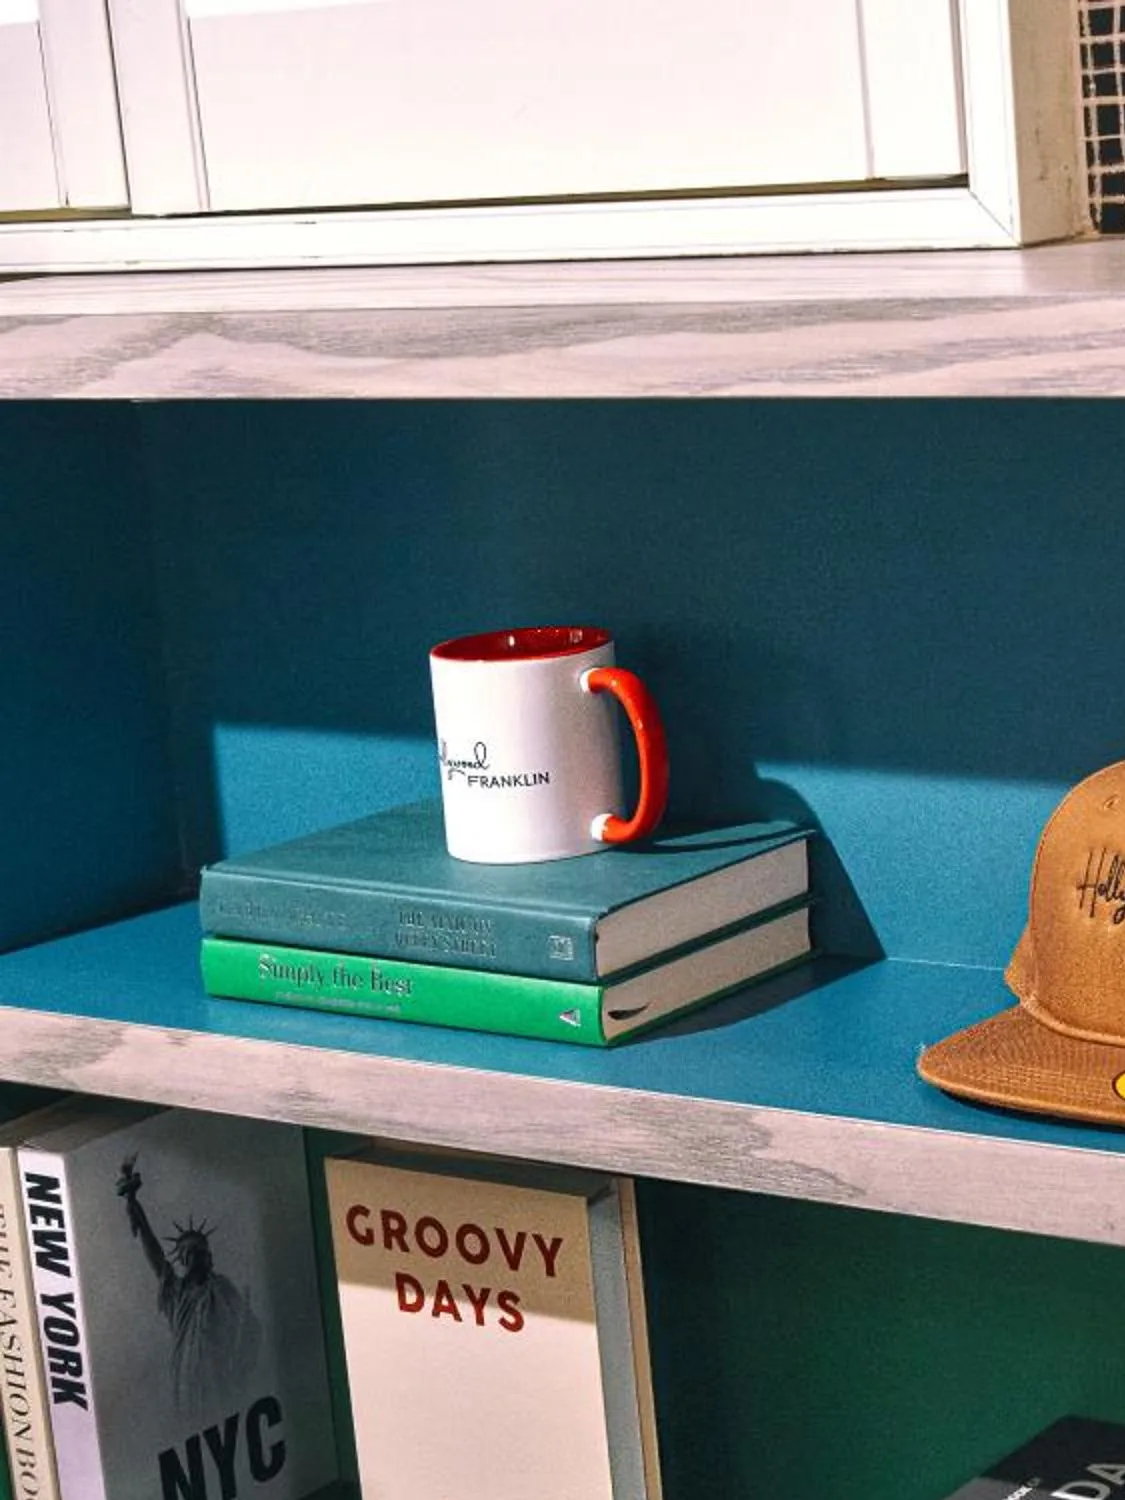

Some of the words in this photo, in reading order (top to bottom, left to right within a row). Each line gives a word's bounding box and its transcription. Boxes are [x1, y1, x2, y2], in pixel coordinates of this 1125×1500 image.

[468, 771, 550, 789] FRANKLIN
[257, 953, 325, 993] Simply
[332, 962, 365, 990] the
[370, 963, 414, 997] Best
[25, 1171, 71, 1279] NEW
[346, 1204, 564, 1278] GROOVY
[394, 1272, 525, 1334] DAYS
[40, 1292, 89, 1412] YORK
